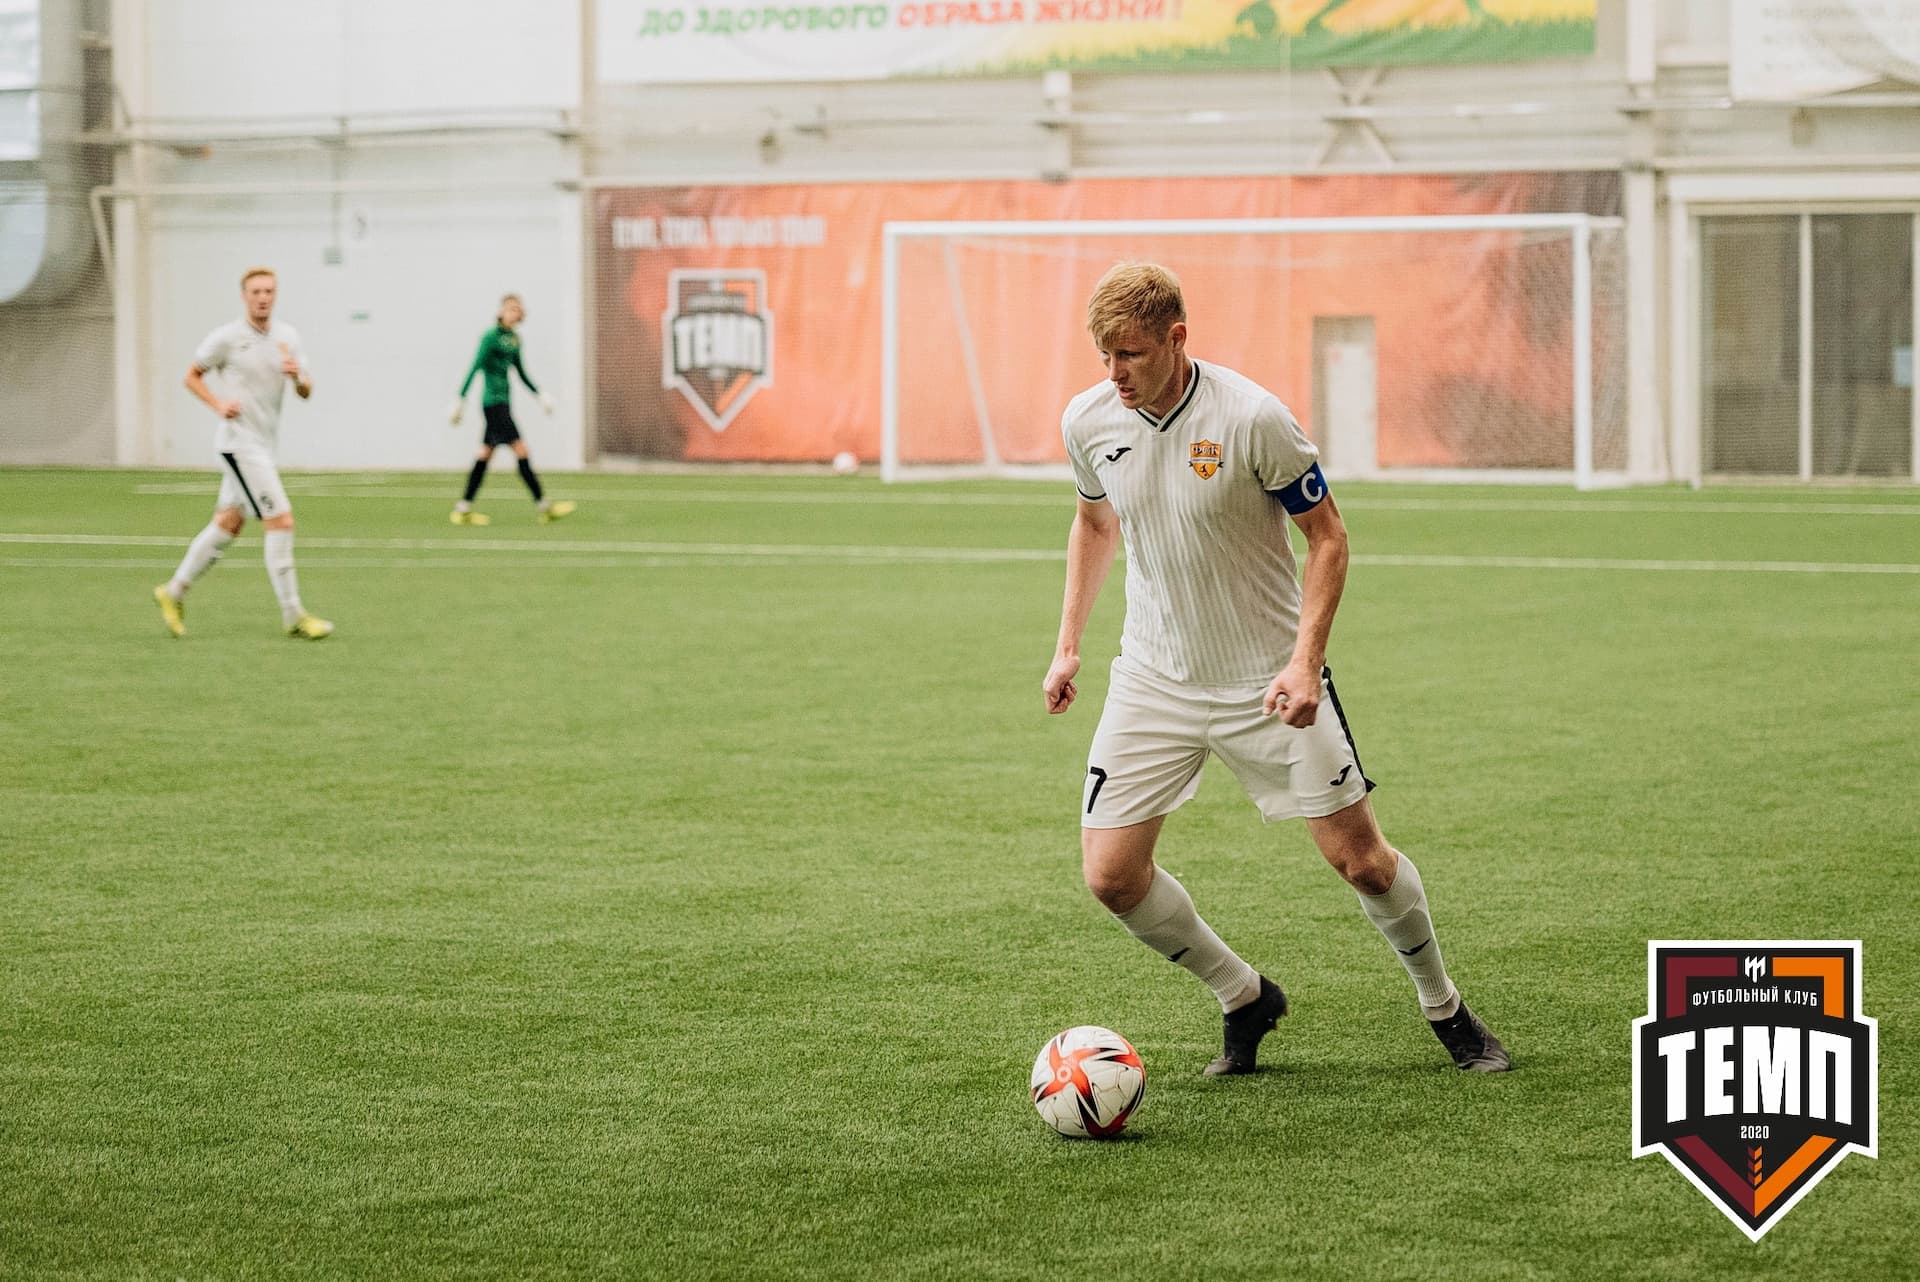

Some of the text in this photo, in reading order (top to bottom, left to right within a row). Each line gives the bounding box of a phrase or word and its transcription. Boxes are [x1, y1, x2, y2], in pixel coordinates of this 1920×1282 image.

[637, 7, 685, 38] ДО
[692, 4, 888, 36] ЗДОРОВОГО
[896, 1, 1025, 27] ОБРАЗА
[1301, 472, 1323, 502] C
[1087, 766, 1107, 814] 7
